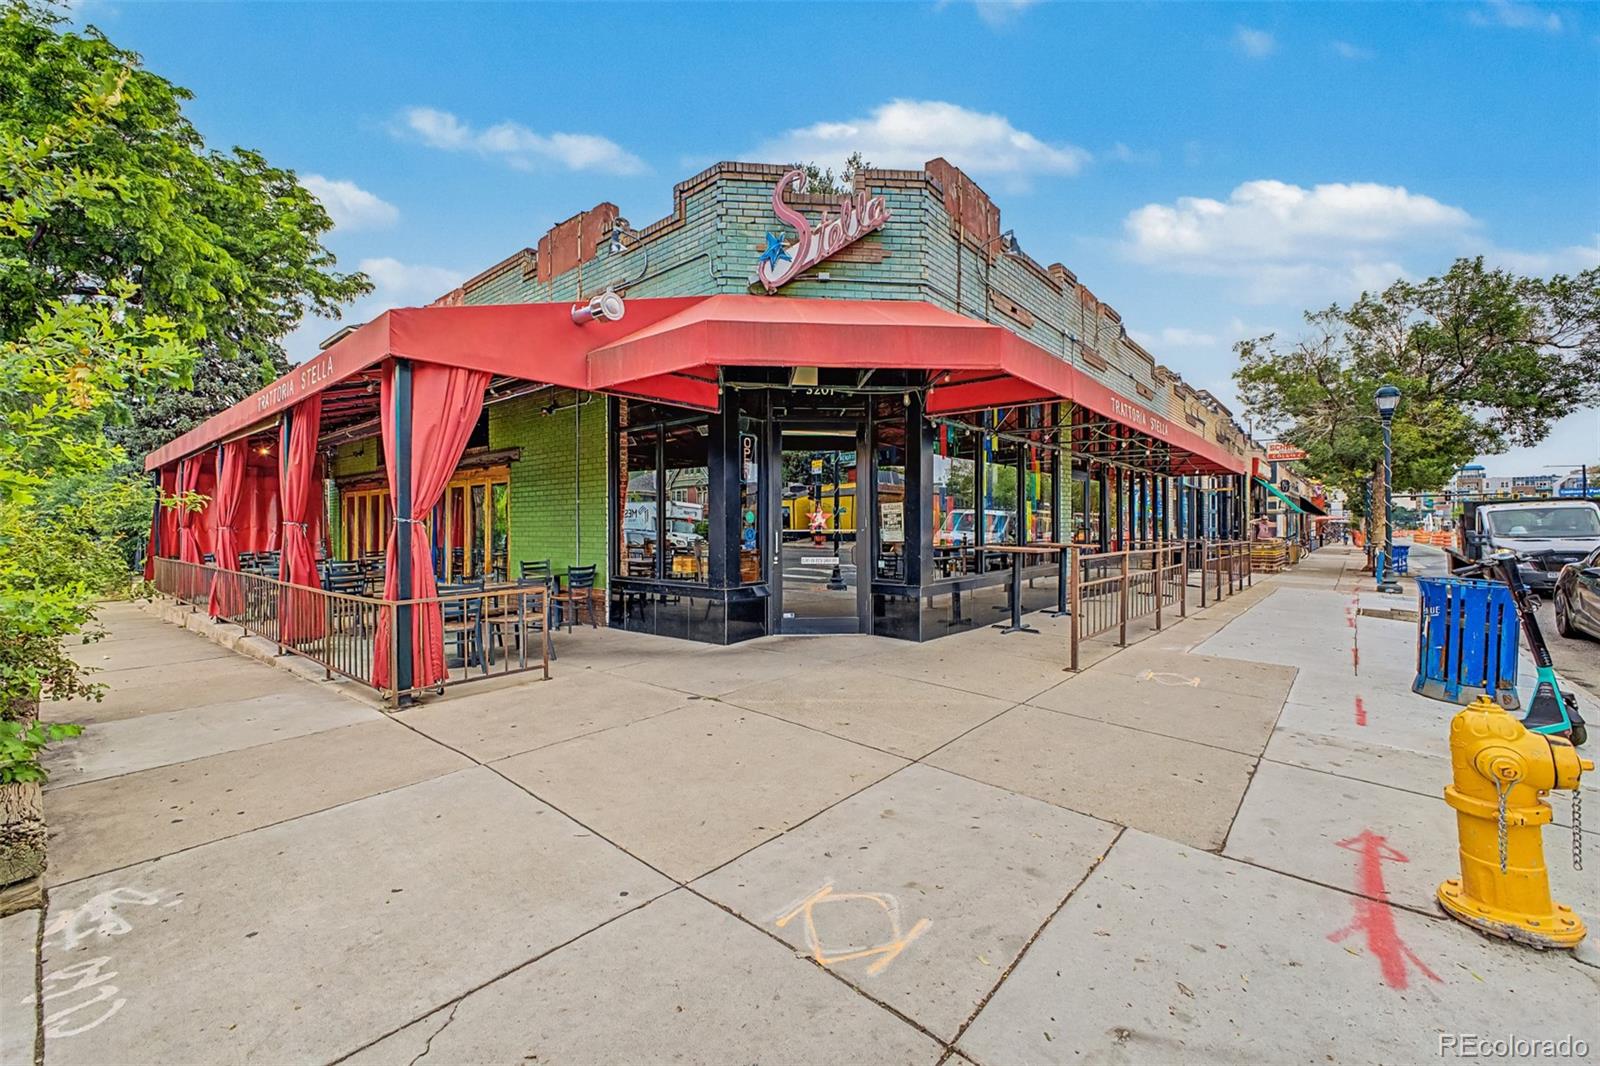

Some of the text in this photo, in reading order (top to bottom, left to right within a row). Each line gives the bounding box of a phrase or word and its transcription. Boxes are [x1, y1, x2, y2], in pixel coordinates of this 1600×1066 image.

[758, 169, 891, 294] Stella
[257, 355, 334, 412] TRATTORIA STELLA
[1111, 397, 1169, 436] TRATTORIA STELLA
